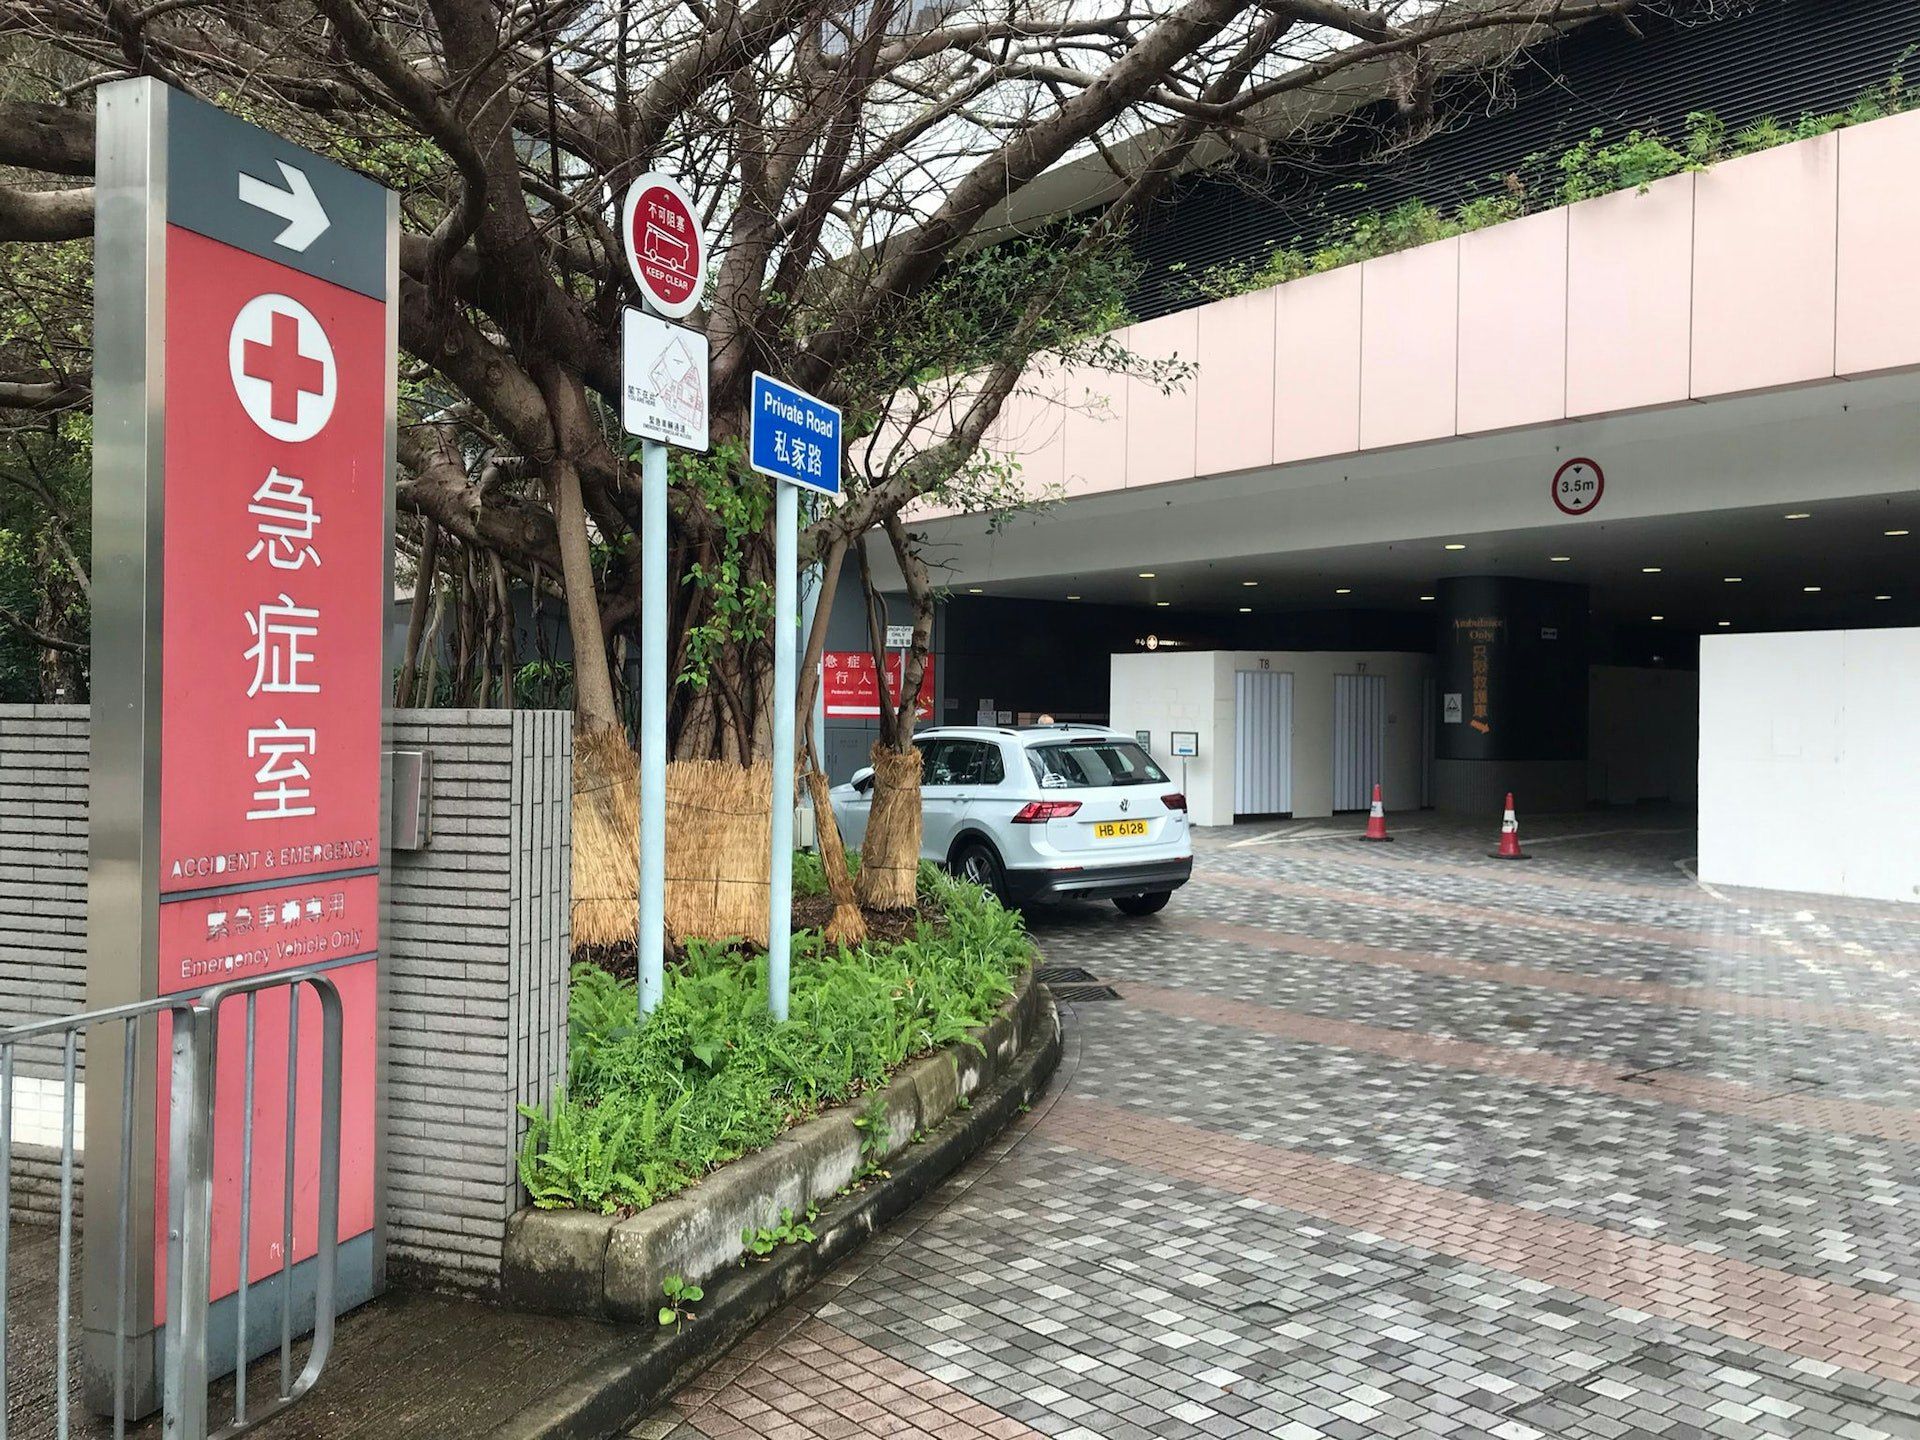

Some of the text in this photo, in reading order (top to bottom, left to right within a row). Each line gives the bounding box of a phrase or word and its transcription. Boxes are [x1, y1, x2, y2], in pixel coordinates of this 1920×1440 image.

[648, 201, 685, 233] 不可阻塞
[646, 265, 688, 291] KEEP CLEAR
[764, 391, 833, 438] Private Road
[774, 430, 822, 477] 私家路
[1561, 480, 1594, 493] 3.5m
[243, 466, 322, 821] 急症室
[1259, 659, 1270, 670] T8
[1356, 663, 1367, 673] T7
[1099, 822, 1144, 837] HB 6128
[171, 838, 372, 878] ACCIDENT & EMERGENCY
[181, 929, 362, 978] Emergency Vehicle Only
